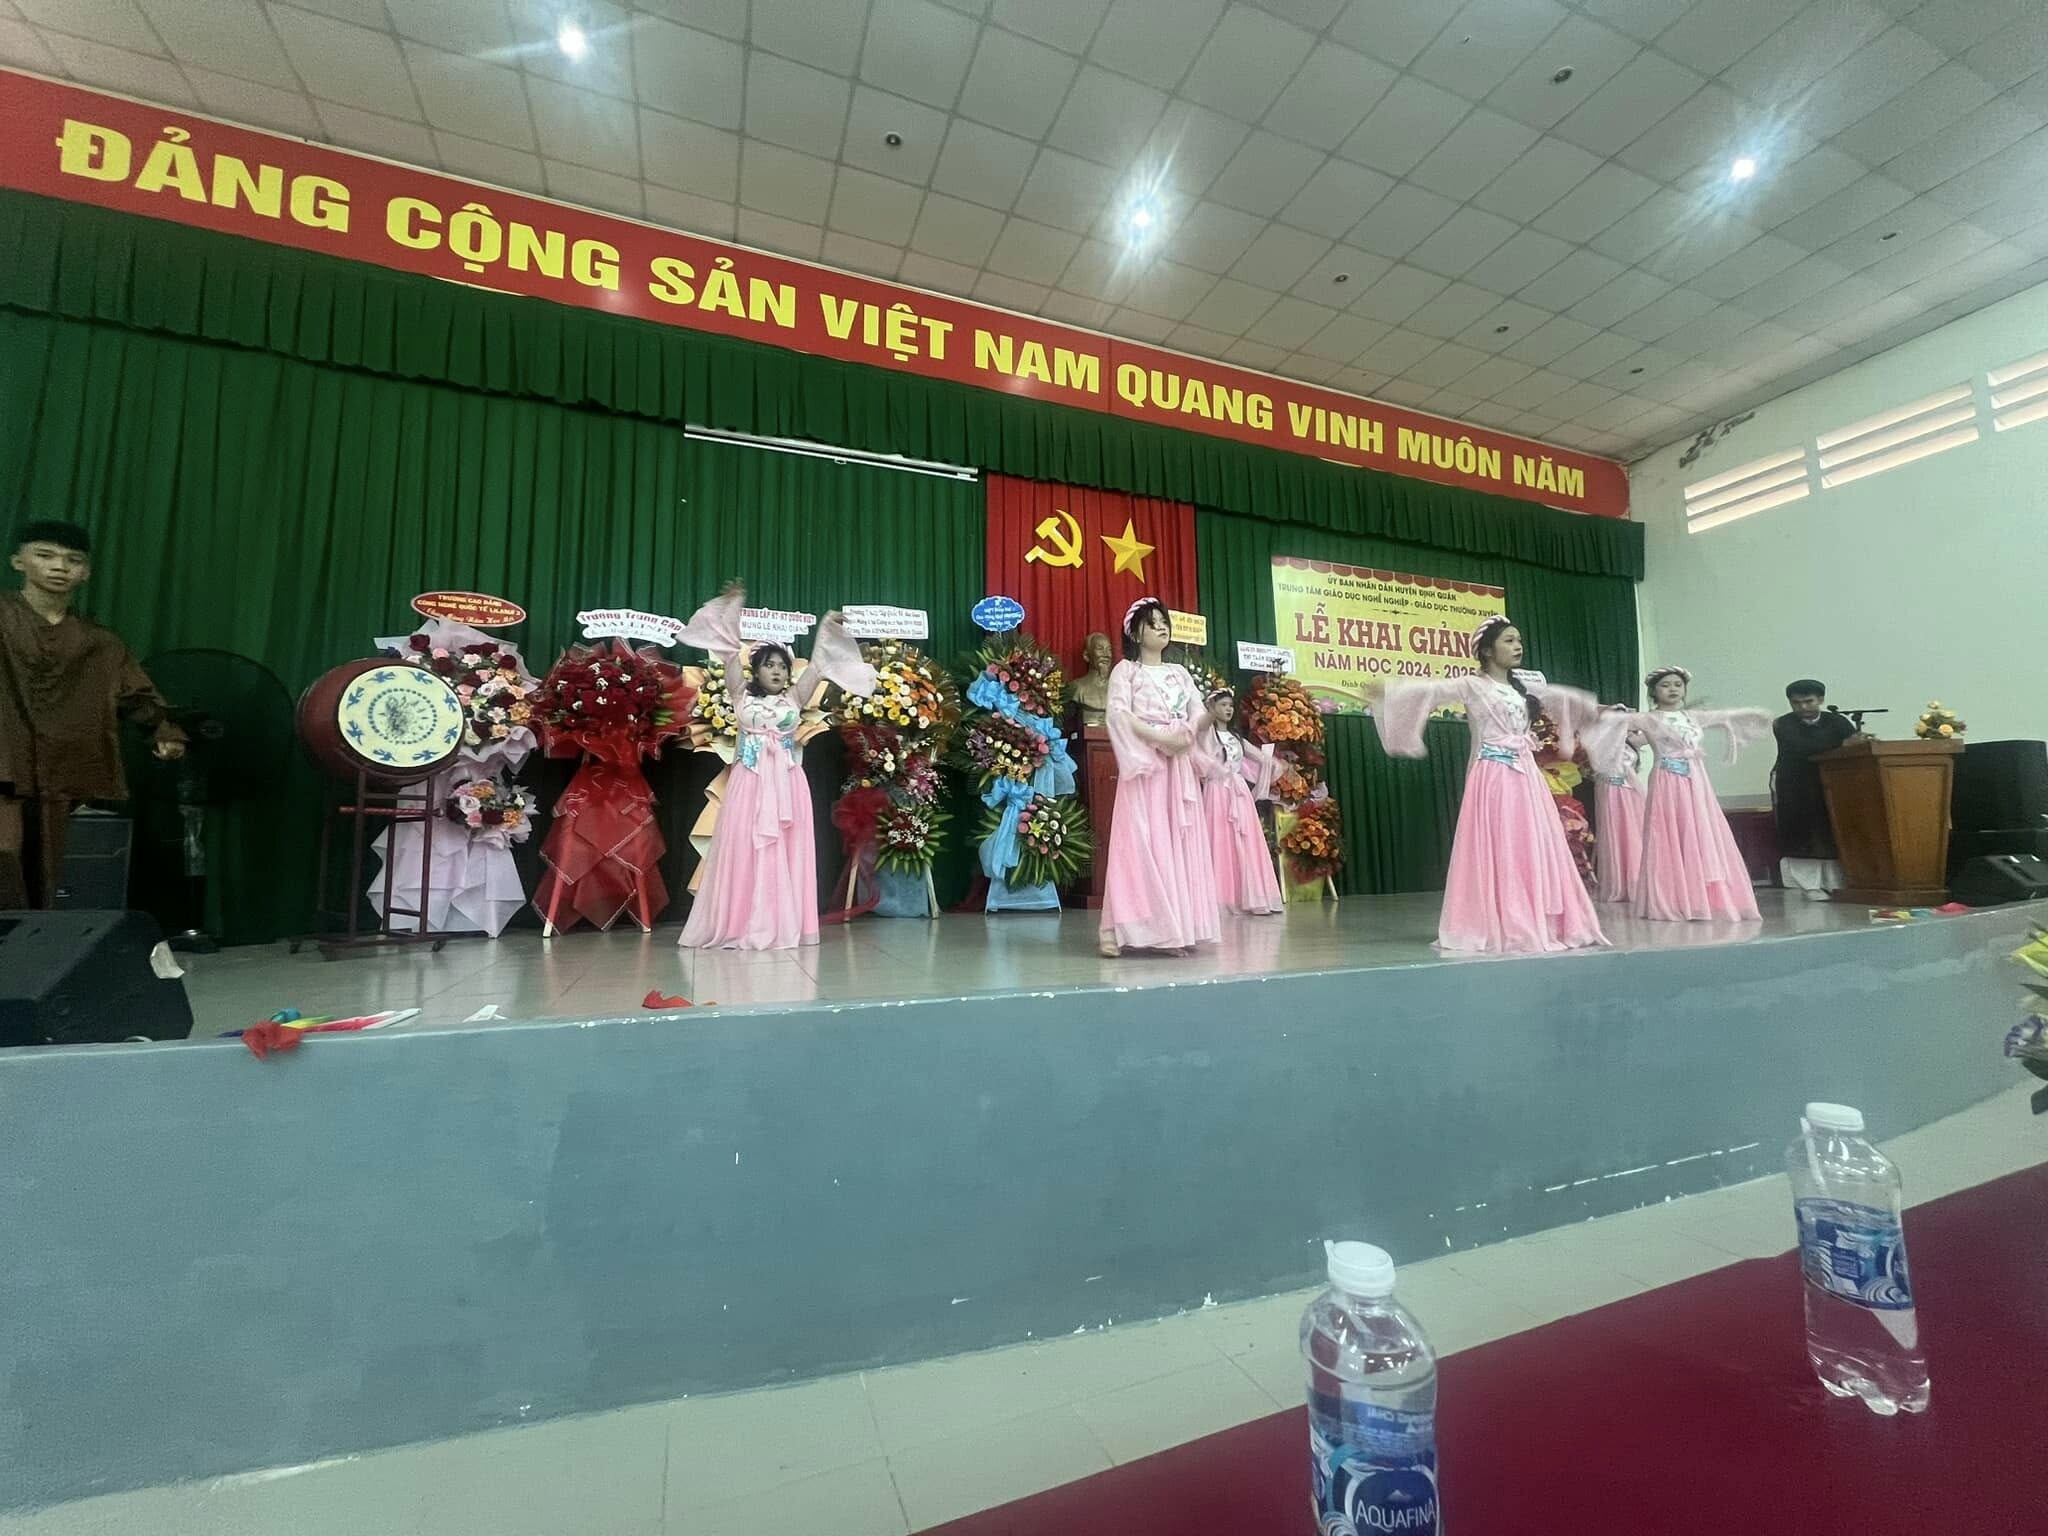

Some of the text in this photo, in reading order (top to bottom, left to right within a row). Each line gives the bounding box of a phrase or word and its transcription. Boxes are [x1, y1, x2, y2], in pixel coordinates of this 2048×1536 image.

[56, 119, 1585, 498] ĐẢNG CỘNG SẢN VIỆT NAM QUANG VINH MUÔN NĂM
[467, 597, 482, 605] CAO
[1278, 583, 1304, 593] TRUNG
[1306, 585, 1322, 595] TÂM
[1323, 587, 1344, 598] GIÁO
[1345, 591, 1361, 602] DỤC
[1362, 593, 1382, 604] NGHỀ
[1383, 596, 1409, 607] NGHIỆP
[1414, 599, 1433, 609] GIÁO
[1434, 603, 1449, 613] DỤC
[1339, 578, 1355, 587] BAN
[1356, 580, 1377, 590] NHÂN
[1378, 582, 1394, 592] DÂN
[1394, 584, 1418, 595] HUYỆN
[1418, 588, 1436, 598] ĐỊNH
[1295, 602, 1471, 658] LỄ KHAI GIẢN
[1314, 649, 1352, 671] NĂM
[1357, 655, 1392, 678] HỌC
[1396, 660, 1432, 678] 2024
[1355, 1497, 1436, 1533] AQUAFINA
